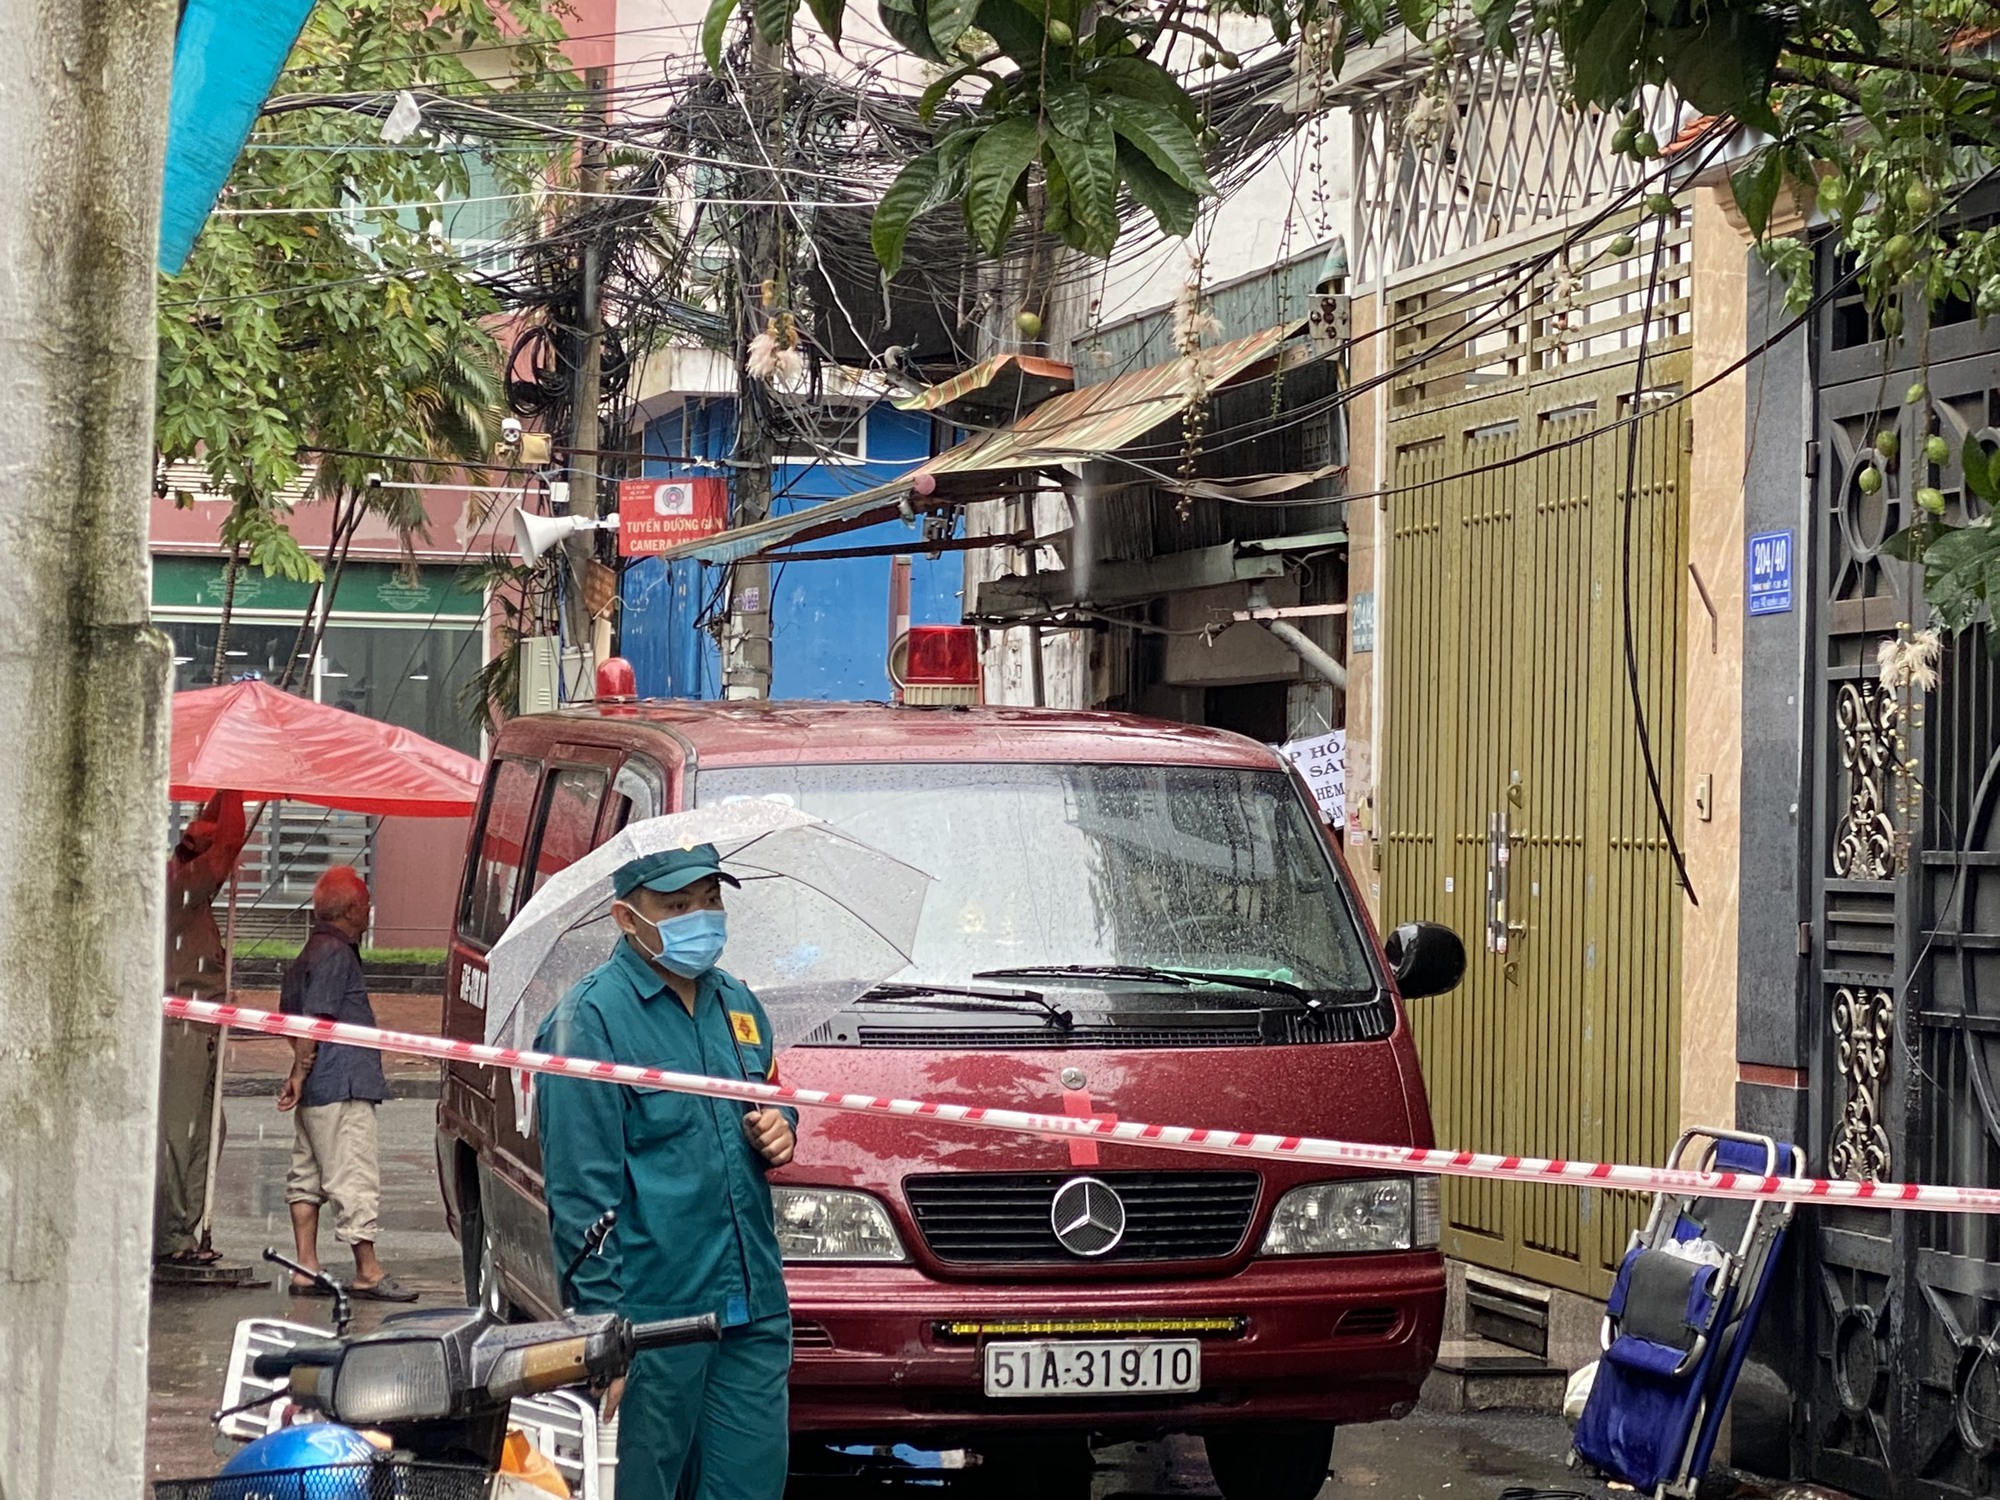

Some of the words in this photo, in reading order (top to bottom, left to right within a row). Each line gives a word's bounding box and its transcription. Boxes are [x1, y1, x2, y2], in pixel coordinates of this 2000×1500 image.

[630, 538, 673, 551] CAMERA
[1755, 539, 1786, 579] 204/40
[1309, 738, 1346, 760] HÓ
